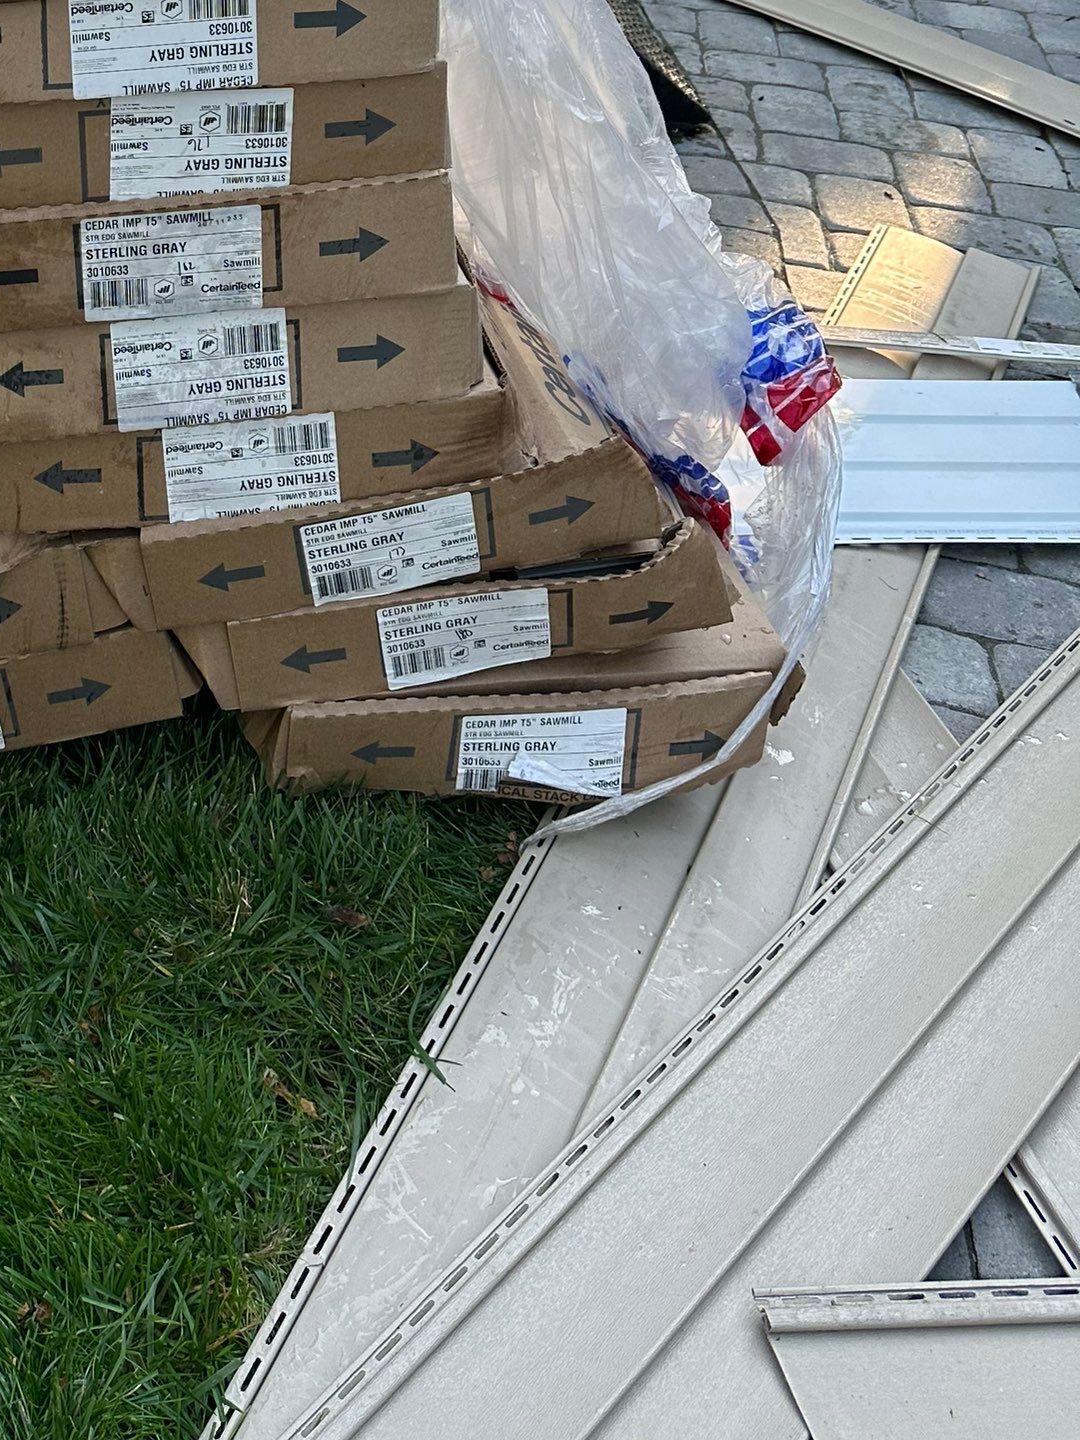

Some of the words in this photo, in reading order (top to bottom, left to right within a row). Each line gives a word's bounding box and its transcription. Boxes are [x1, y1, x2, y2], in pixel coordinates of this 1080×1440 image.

[71, 2, 133, 17] CertainTeed
[209, 21, 252, 35] 3010633
[73, 31, 110, 44] Sawmill
[149, 49, 184, 62] GRAY
[190, 42, 253, 58] STERLING
[187, 65, 220, 75] SAWMILL
[238, 62, 253, 70] STR
[196, 78, 215, 90] IMP
[219, 75, 253, 86] CEDAR
[122, 82, 170, 95] SAWMILL
[112, 116, 172, 125] CertainTeed
[111, 141, 148, 152] Sawmill
[245, 137, 287, 149] 3010633
[185, 159, 219, 171] GRAY
[225, 156, 287, 169] STERLING
[222, 176, 254, 184] SAWMILL
[85, 219, 118, 231] CEDAR
[123, 218, 141, 227] IMP
[146, 216, 162, 226] T5"
[166, 212, 213, 224] SAWMILL
[86, 245, 147, 260] STERLING
[153, 242, 187, 254] GRAY
[223, 258, 260, 268] Sawmill
[86, 265, 128, 277] 3010633
[201, 281, 260, 293] CertainTeed
[114, 342, 171, 356] CertainTeed
[244, 355, 284, 369] 3010633
[116, 369, 152, 381] Sawmill
[227, 374, 285, 391] STERLING
[189, 384, 221, 396] GRAY
[233, 409, 251, 419] IMP
[255, 405, 287, 416] CEDAR
[164, 413, 209, 427] SAWMILL
[166, 441, 223, 454] CertainTeed
[294, 453, 334, 466] 3010633
[168, 466, 203, 478] Sawmill
[240, 478, 272, 491] GRAY
[278, 471, 336, 487] STERLING
[304, 523, 336, 536] CEDAR
[340, 519, 358, 529] IMP
[361, 516, 378, 524] T5"
[382, 505, 427, 520] SAWMILL
[308, 540, 367, 559] STERLING
[372, 532, 404, 546] GRAY
[441, 535, 476, 547] Sawmill
[312, 559, 351, 573] 3010633
[382, 606, 413, 617] CEDAR
[417, 602, 434, 611] IMP
[438, 599, 453, 607] T5"
[458, 594, 502, 605] SAWMILL
[385, 622, 441, 640] STERLING
[446, 616, 478, 628] GRAY
[513, 623, 548, 632] Sawmill
[387, 640, 426, 653] 3010633
[466, 720, 496, 729] CEDAR
[500, 720, 517, 728] IMP
[521, 718, 537, 726] T5"
[540, 716, 583, 725] SAWMILL
[463, 742, 520, 751] STERLING
[525, 742, 557, 751] GRAY
[589, 757, 621, 766] Sawmill
[534, 791, 579, 802] STACK
